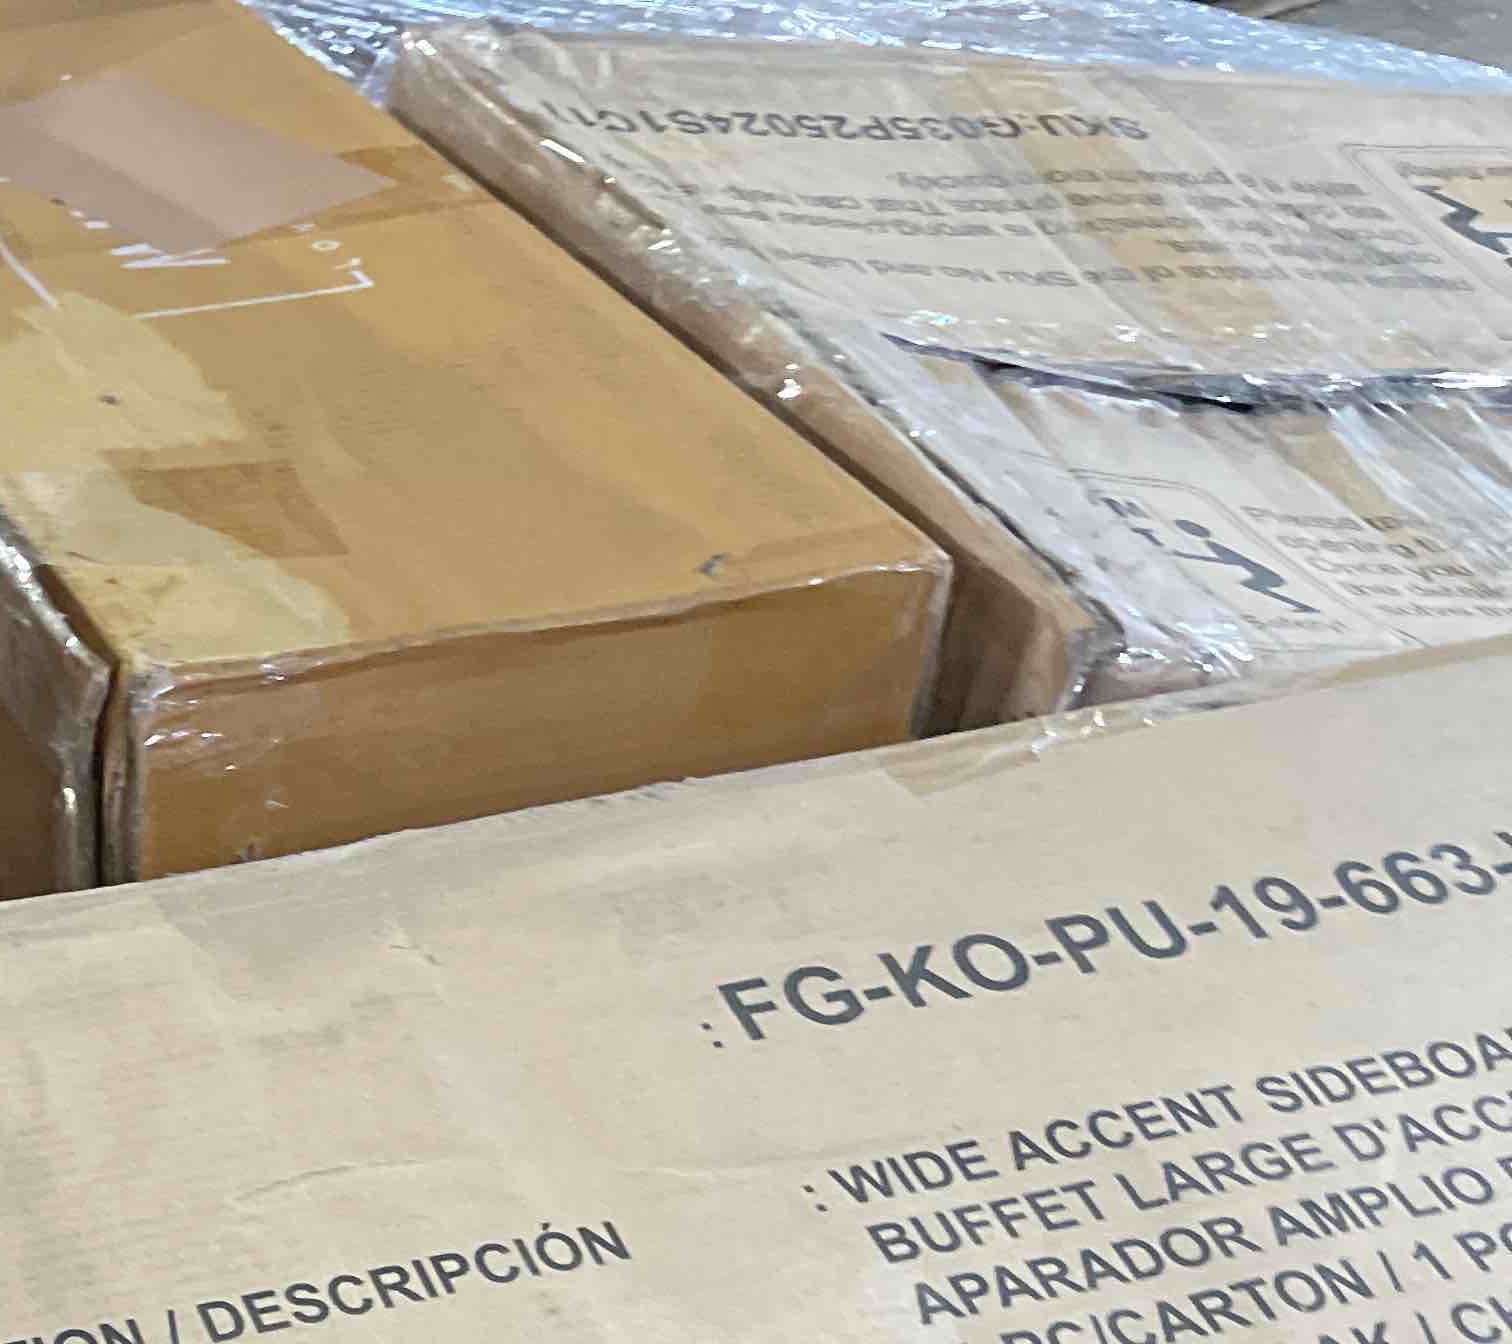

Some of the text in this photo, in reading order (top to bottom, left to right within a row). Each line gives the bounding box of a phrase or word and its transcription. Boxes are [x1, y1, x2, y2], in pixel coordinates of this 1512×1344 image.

[716, 831, 1512, 1042] FG-KO-PU-19-663-
[826, 1138, 1001, 1205] WIDE
[1007, 1083, 1245, 1173] ACCENT
[1254, 1027, 1512, 1114] SIDEBOA
[864, 1092, 1512, 1265] BUFFET LARGE D'ACC
[194, 1219, 633, 1344] DESCRIPCIÓN
[914, 1166, 1496, 1327] APARADOR AMPLIO
[1411, 1241, 1454, 1281] 1
